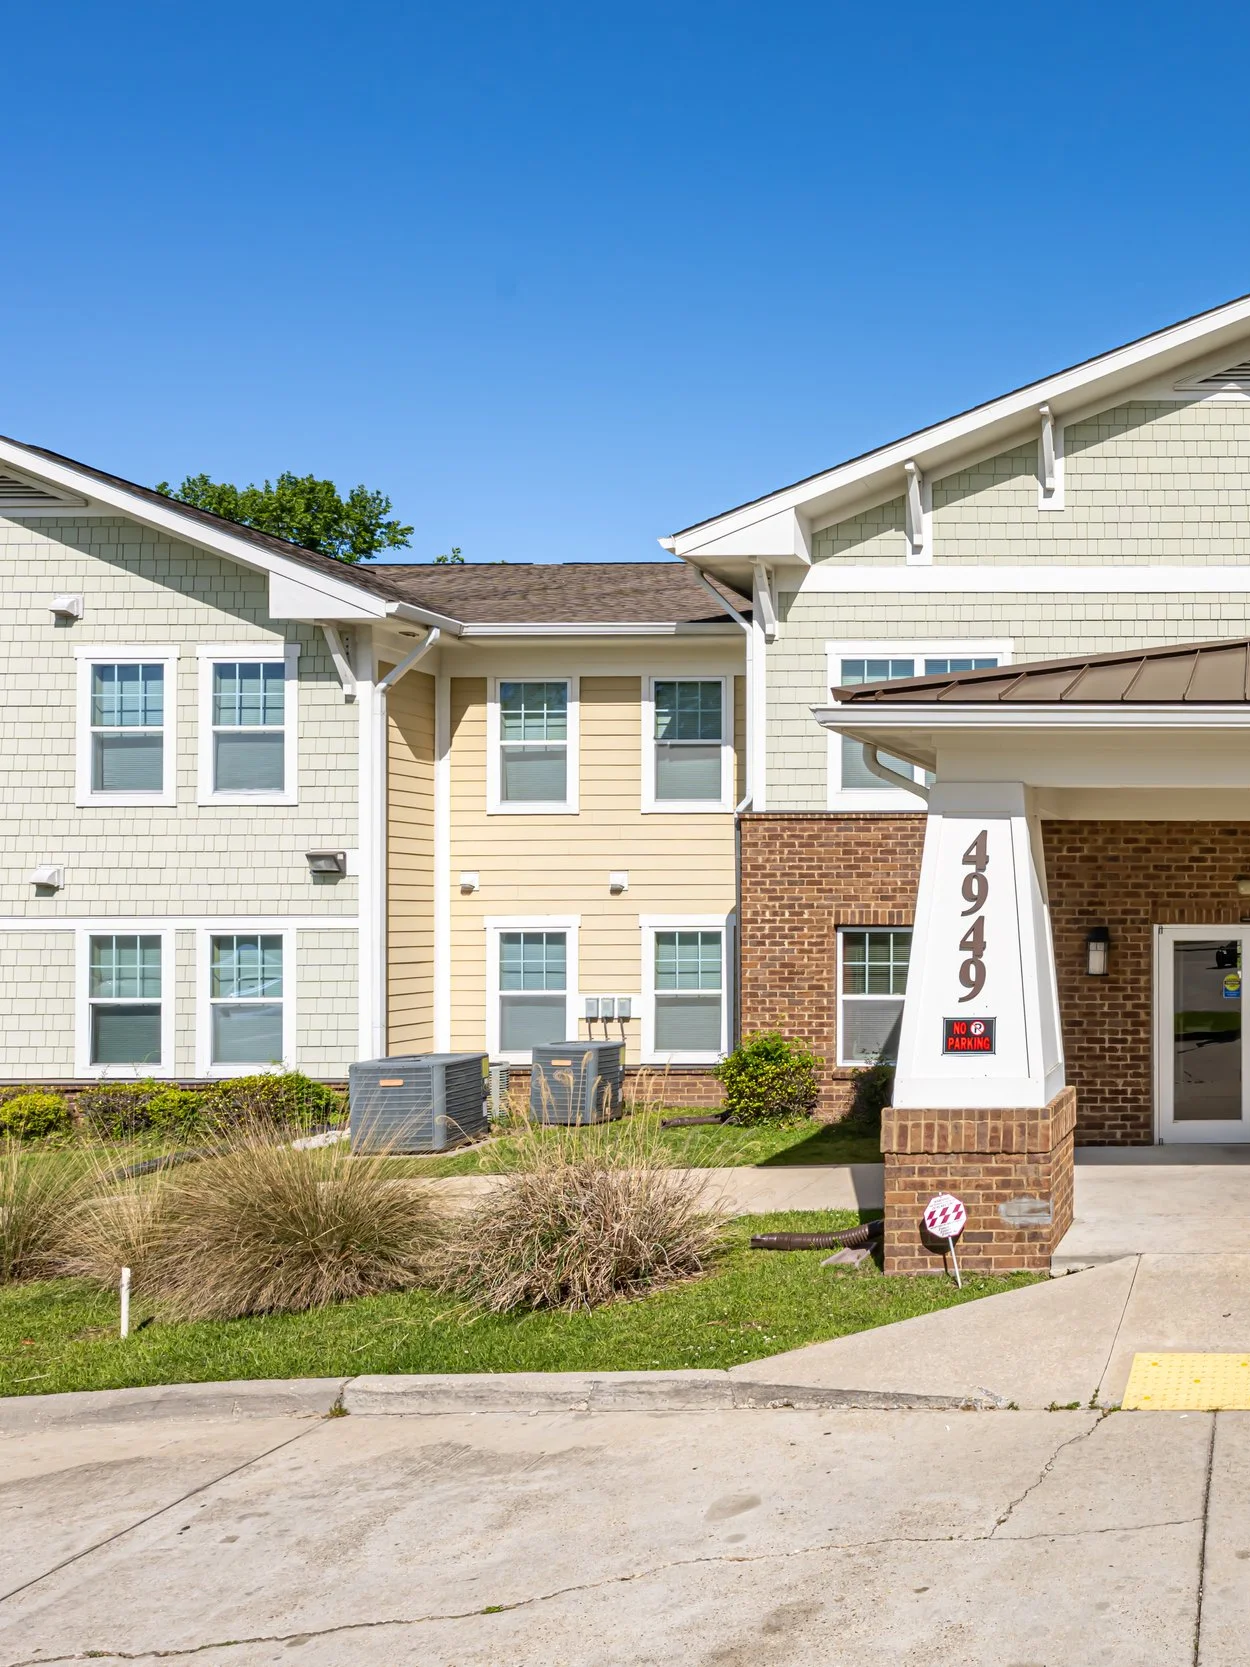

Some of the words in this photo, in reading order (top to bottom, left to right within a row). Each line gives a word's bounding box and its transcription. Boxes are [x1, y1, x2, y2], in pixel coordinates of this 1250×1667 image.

[958, 829, 990, 1003] 4949
[953, 1021, 967, 1035] NO
[948, 1036, 991, 1050] PARKING
